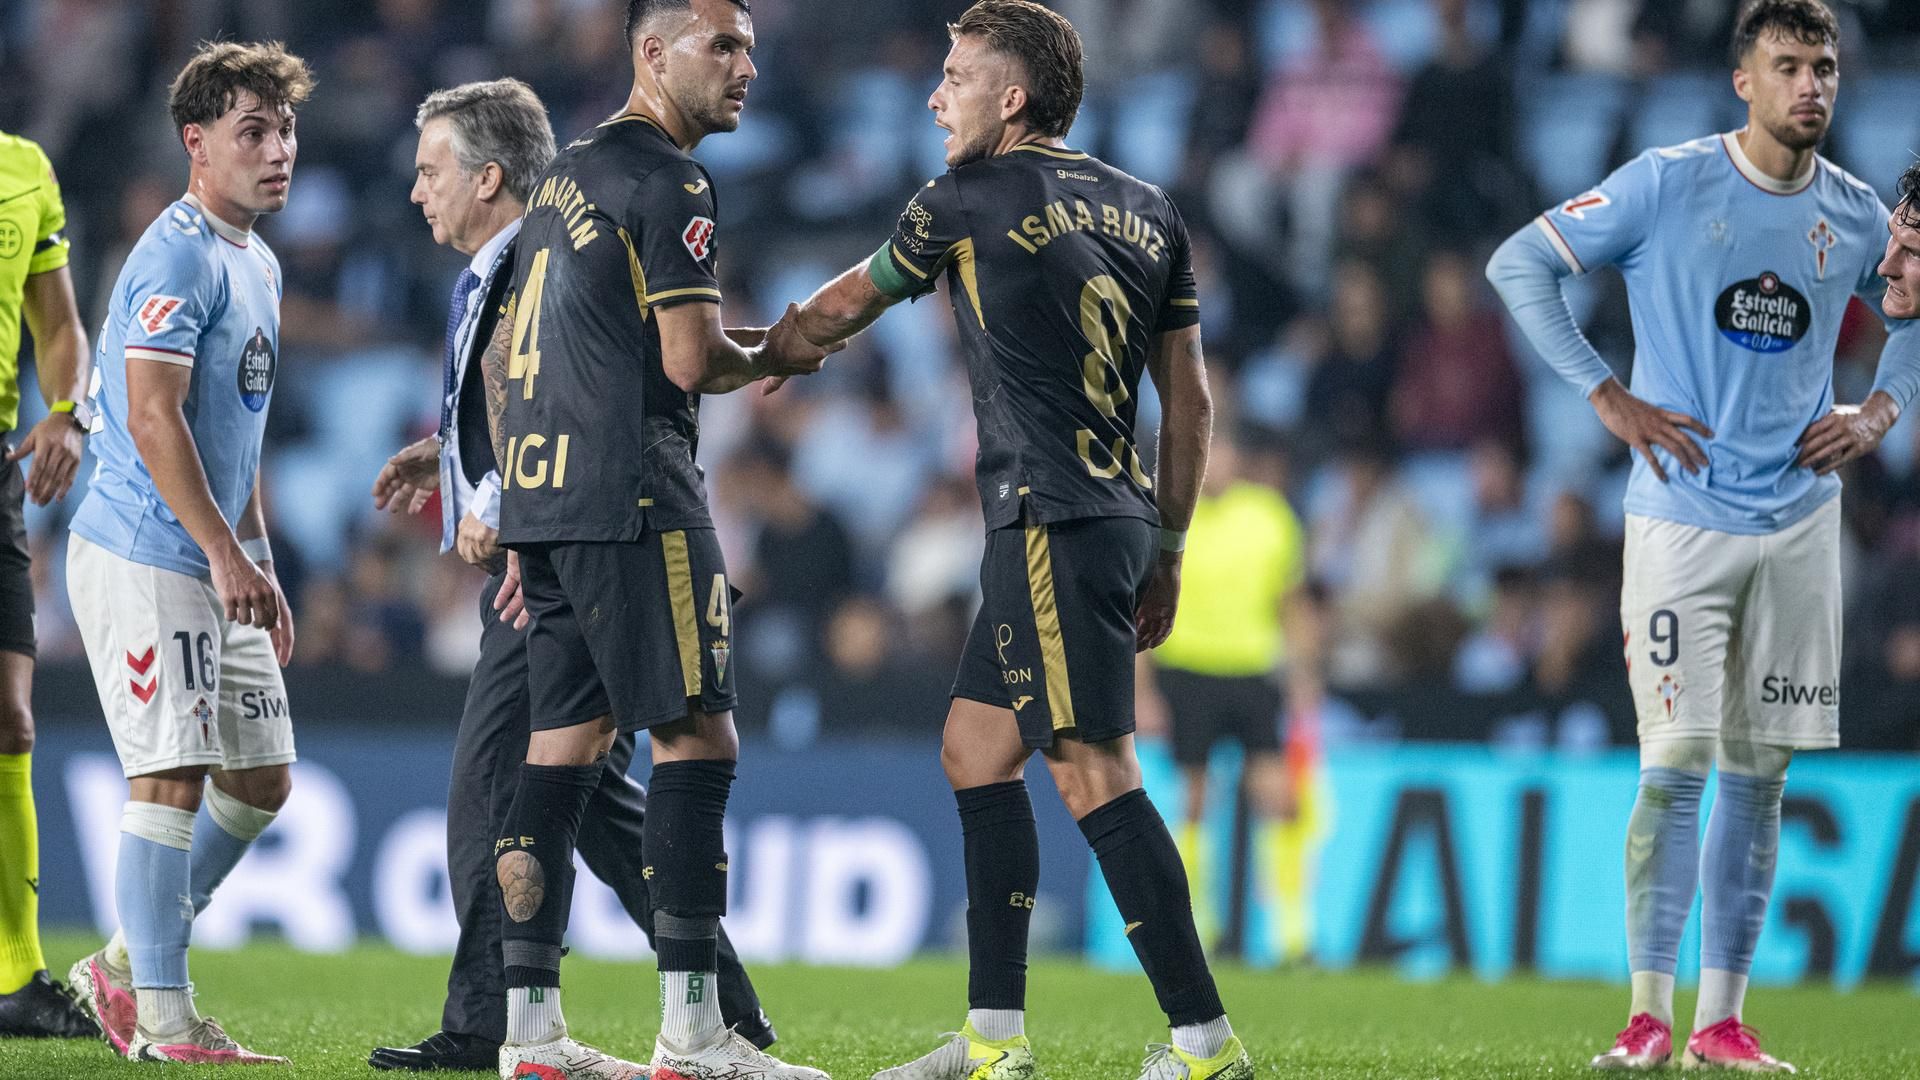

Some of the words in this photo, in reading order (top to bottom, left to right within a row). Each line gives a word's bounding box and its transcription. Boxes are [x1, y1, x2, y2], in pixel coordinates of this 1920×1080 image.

[1007, 200, 1095, 255] ISMA
[1102, 203, 1168, 264] RUIZ
[508, 248, 550, 401] 4
[1731, 288, 1798, 319] Estrella
[1731, 308, 1793, 337] Galicia
[1080, 274, 1134, 418] 8
[503, 433, 570, 490] IGI
[706, 573, 730, 637] 4
[173, 631, 216, 693] 16
[1649, 609, 1679, 668] 9
[241, 690, 287, 720] Siw
